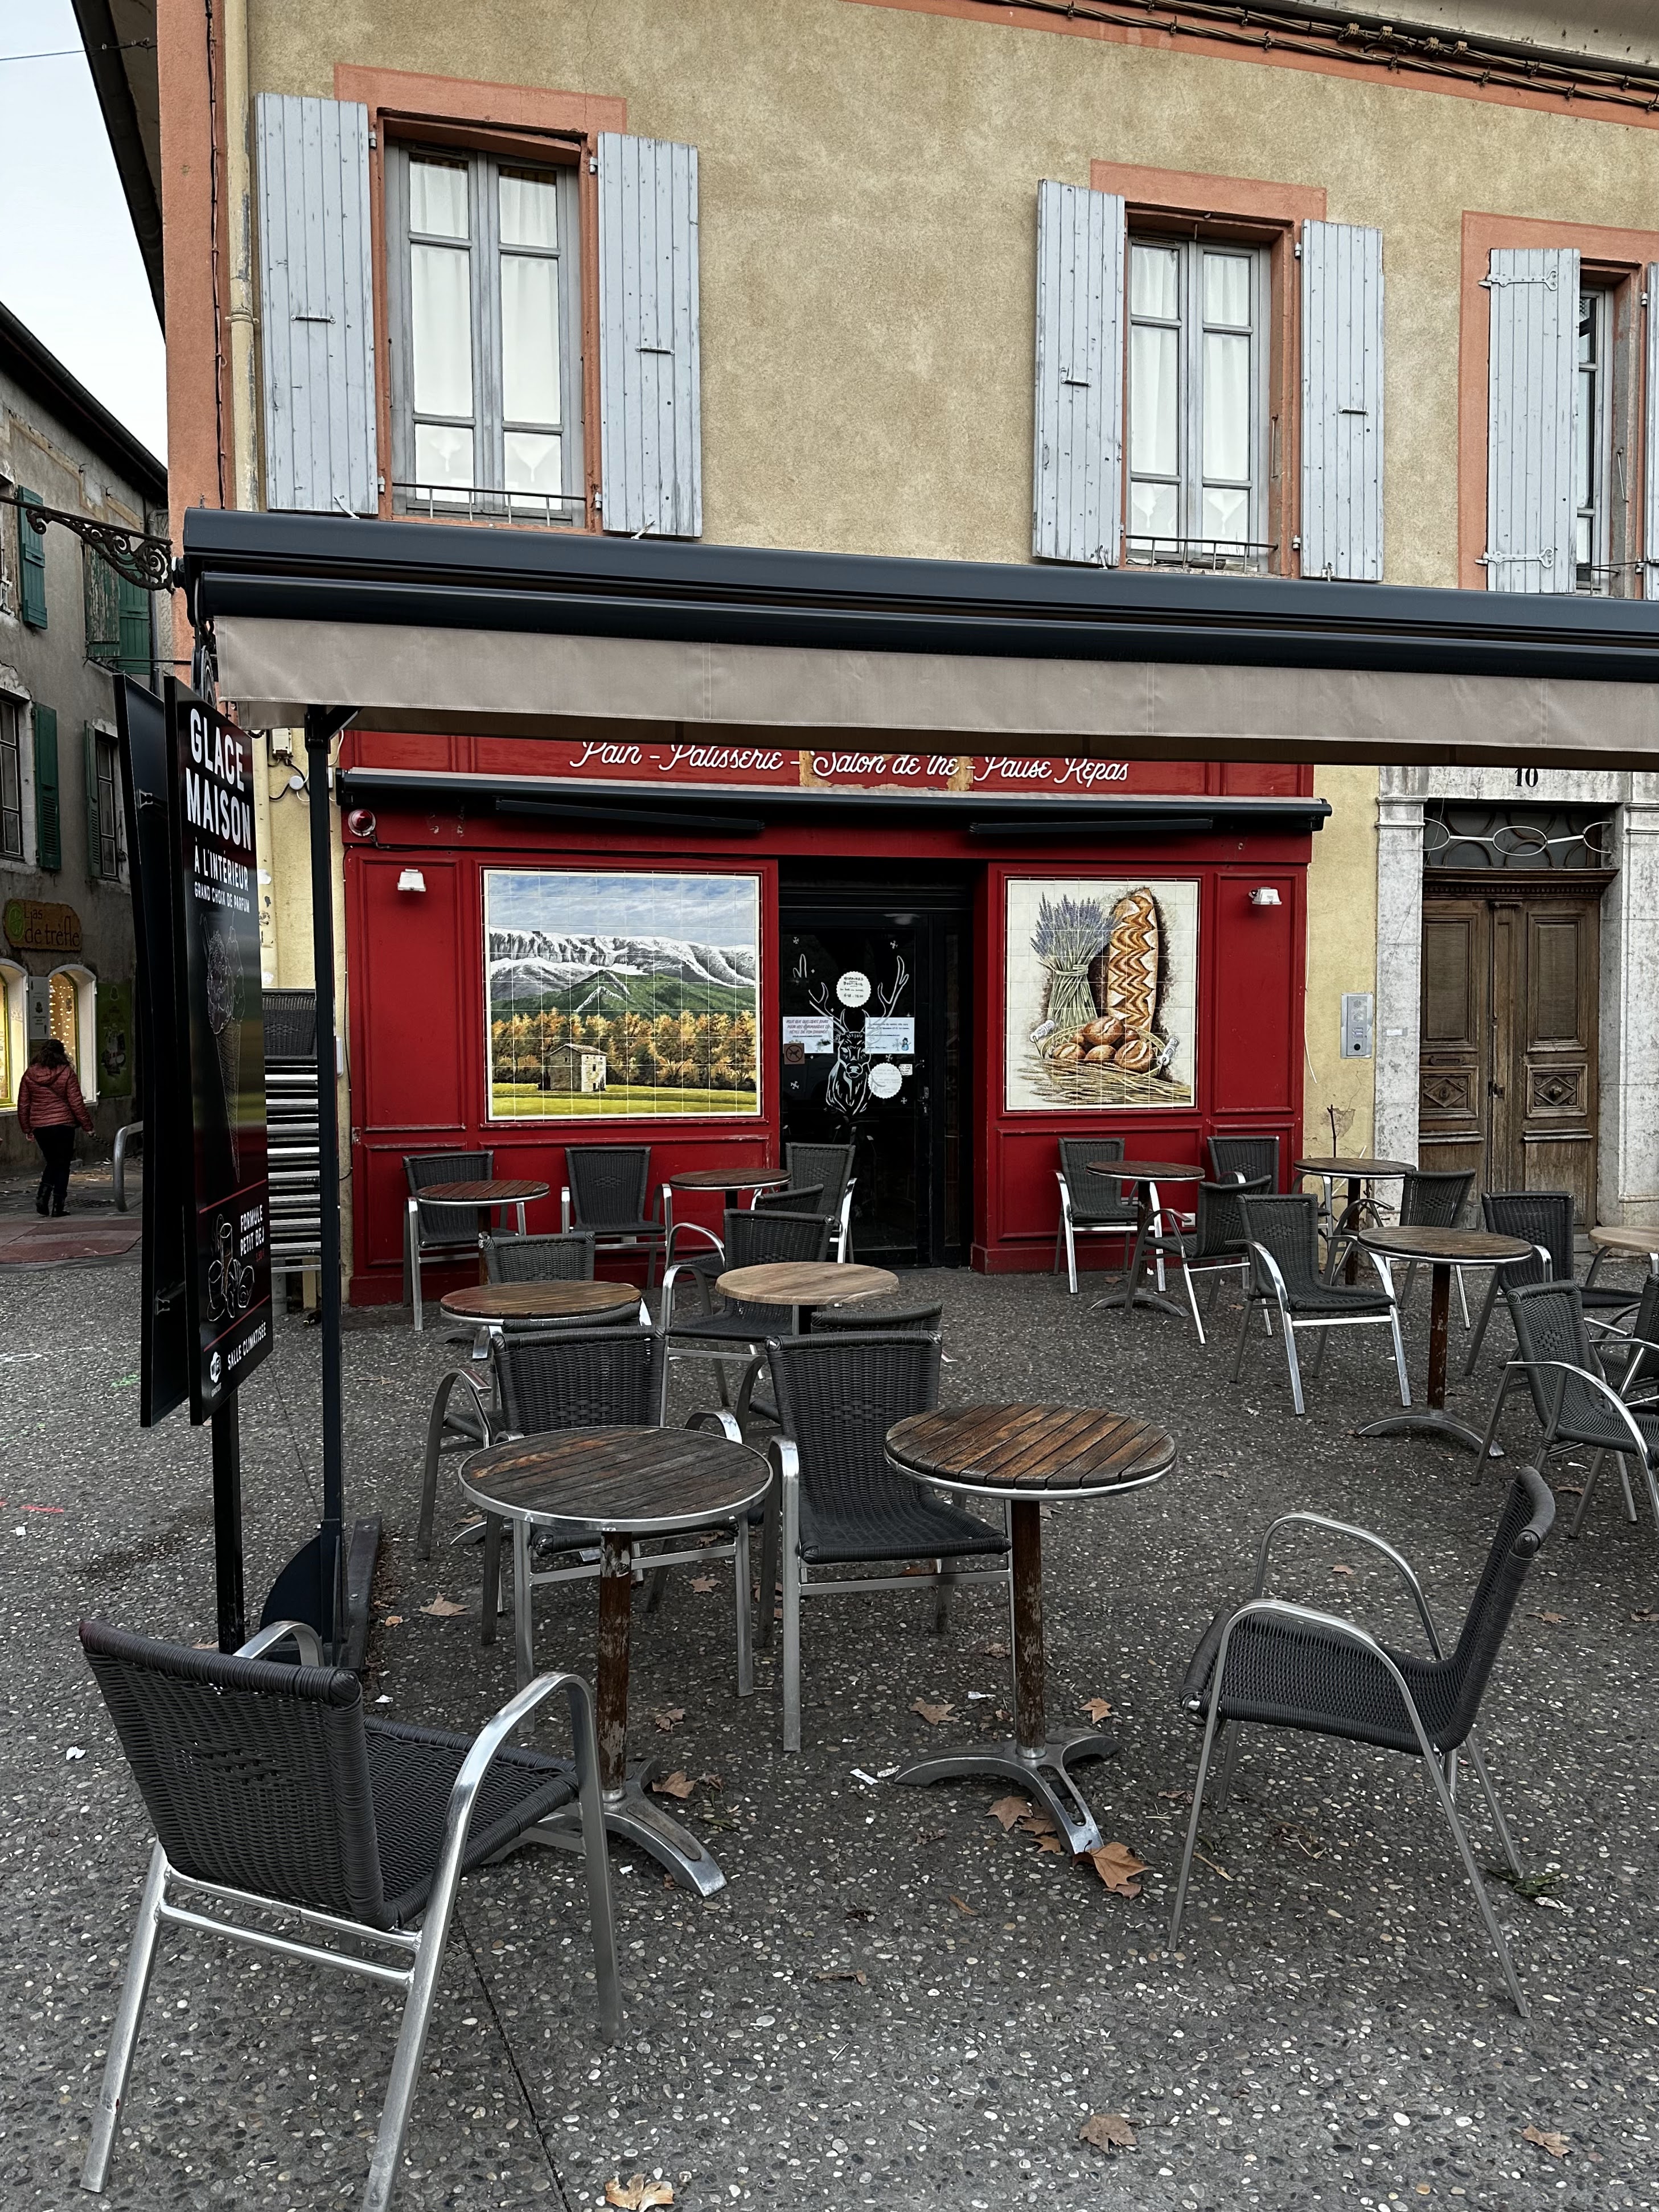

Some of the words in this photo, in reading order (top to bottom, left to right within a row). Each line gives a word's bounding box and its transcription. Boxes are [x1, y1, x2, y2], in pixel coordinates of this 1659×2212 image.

[190, 708, 245, 792] GLACE
[569, 742, 643, 767] Pain
[892, 754, 922, 775] de
[974, 756, 1053, 781] Pause
[1514, 768, 1539, 788] 10
[185, 767, 252, 852] MAISON
[194, 836, 200, 874] À
[203, 848, 249, 892] L'INTÉRIEUR
[194, 881, 211, 901] GRAND
[212, 887, 226, 906] CHOIX
[227, 893, 233, 908] DE
[234, 894, 250, 913] PARFUM
[24, 910, 42, 944] de
[44, 915, 80, 947] trèfle
[240, 1204, 263, 1234] FORMULE
[240, 1232, 254, 1257] PETIT
[255, 1223, 264, 1247] DÉJ
[228, 1344, 242, 1371] SALLE
[243, 1319, 266, 1356] CLIMATISÉE
